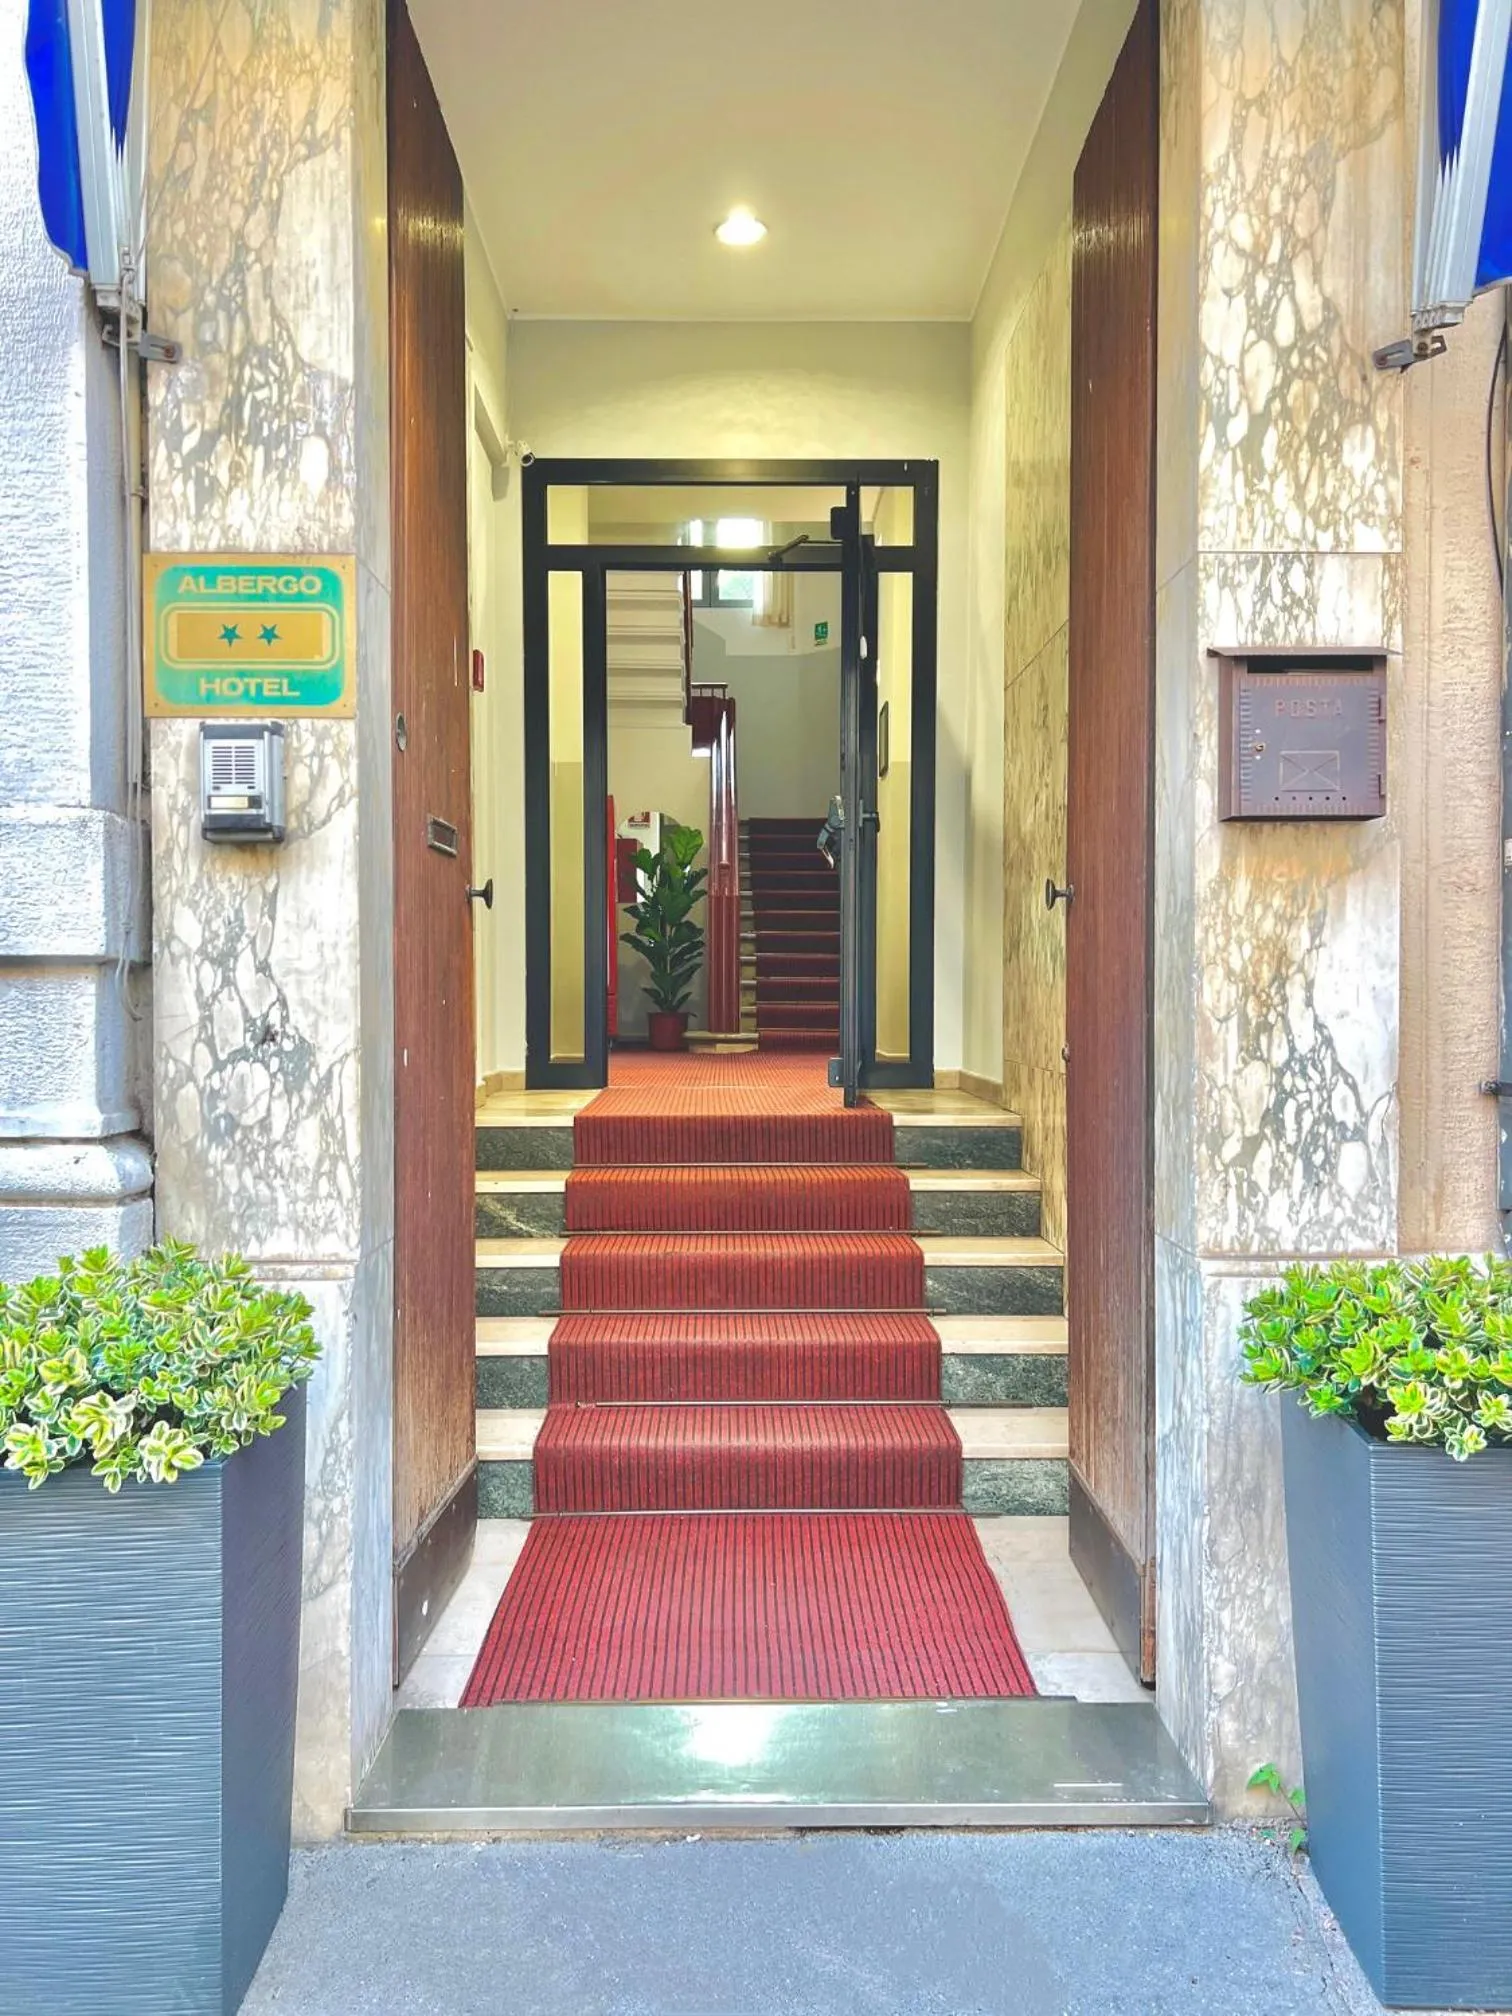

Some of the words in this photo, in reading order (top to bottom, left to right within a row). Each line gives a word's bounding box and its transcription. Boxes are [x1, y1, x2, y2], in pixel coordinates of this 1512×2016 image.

[178, 575, 322, 595] ALBERGO
[199, 677, 301, 697] HOTEL
[1275, 698, 1343, 719] POSTA
